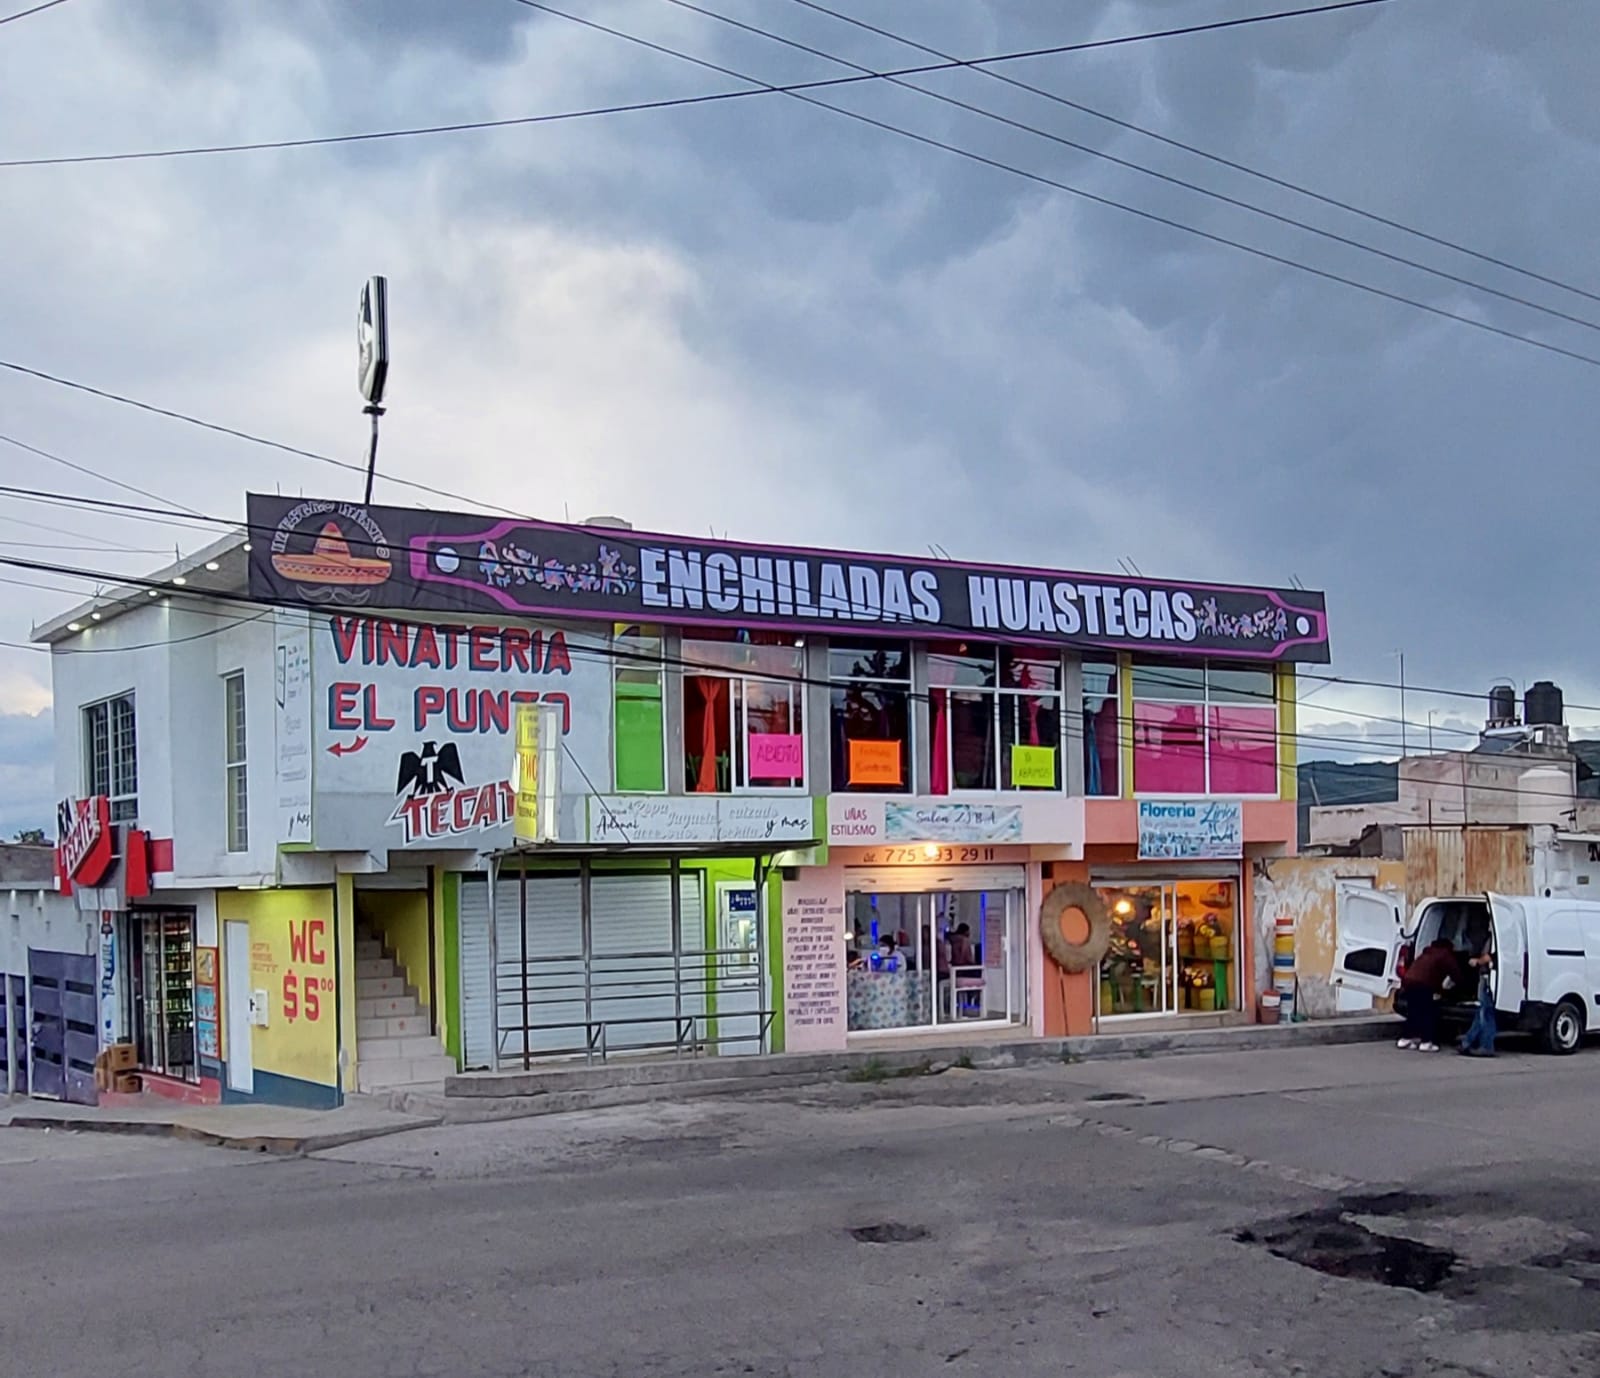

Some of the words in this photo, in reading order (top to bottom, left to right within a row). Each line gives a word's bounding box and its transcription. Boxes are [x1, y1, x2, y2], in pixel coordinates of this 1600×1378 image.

[640, 548, 941, 624] ENCHILADAS
[967, 575, 1198, 642] HUASTECAS
[330, 614, 572, 675] VINATERIA
[329, 682, 395, 731] EL
[831, 824, 877, 837] ESTILISMO
[844, 807, 868, 821] UÑAS
[960, 847, 978, 862] 29
[288, 919, 326, 965] WC
